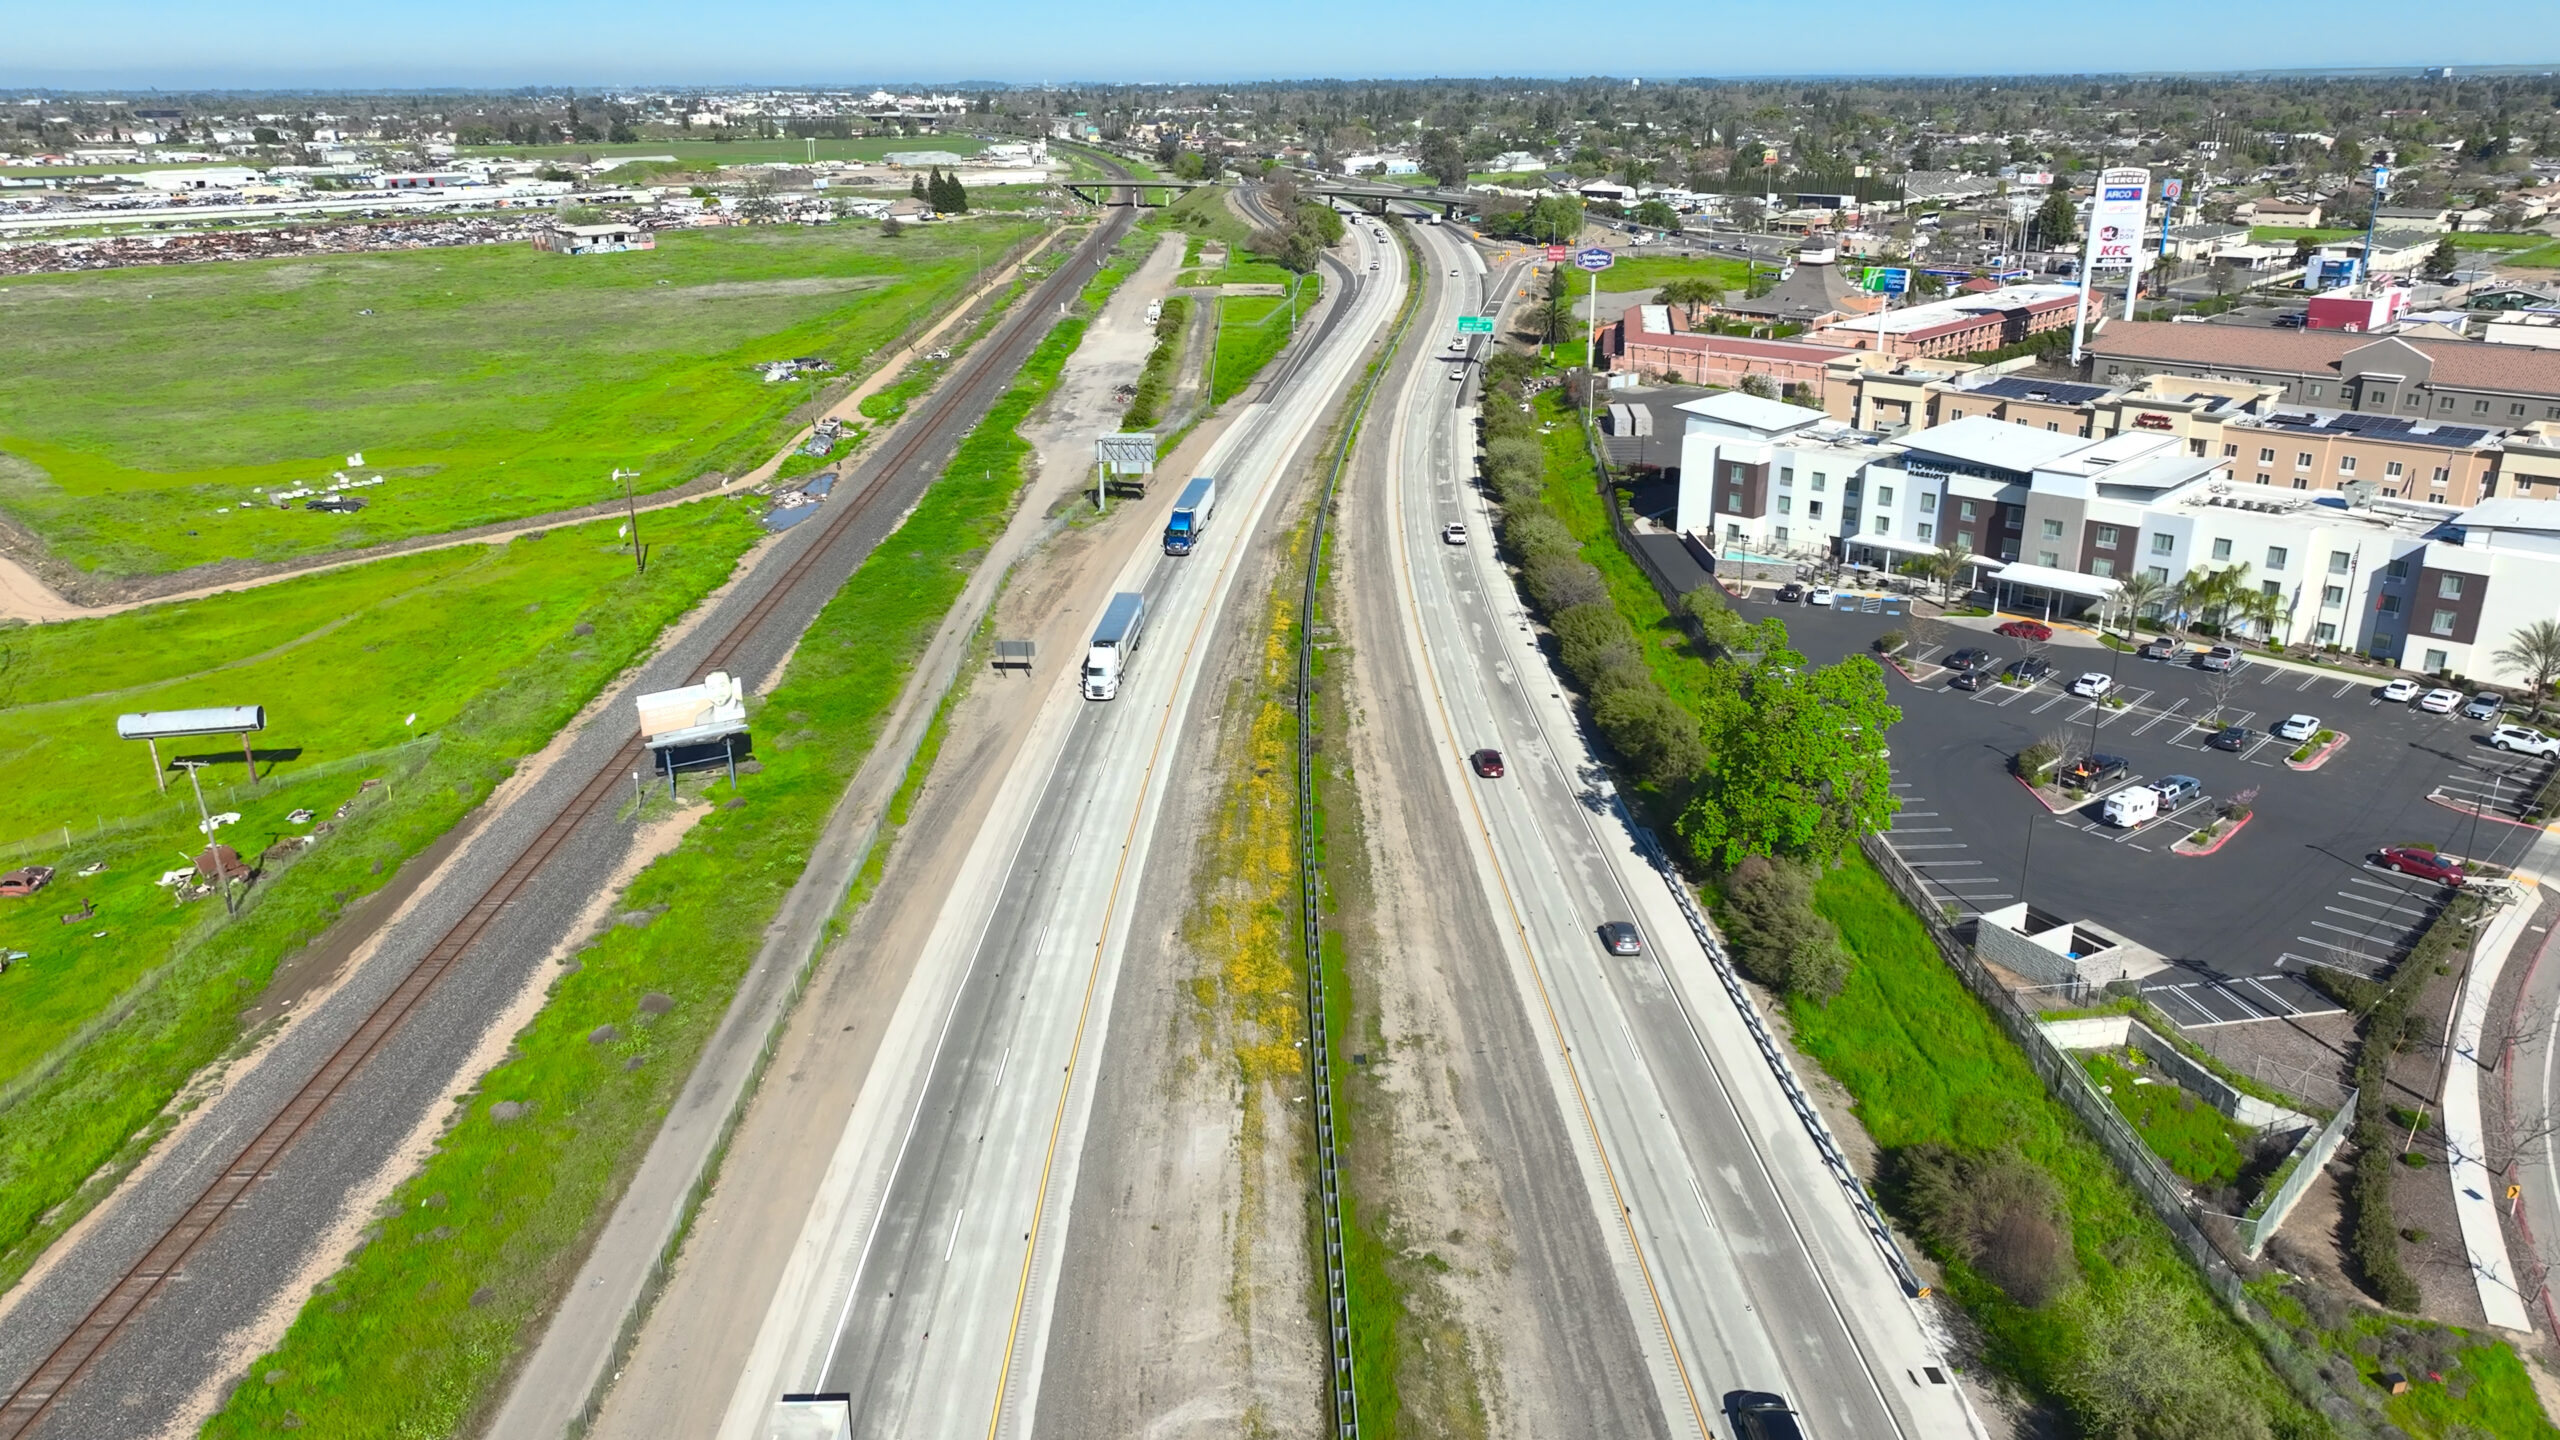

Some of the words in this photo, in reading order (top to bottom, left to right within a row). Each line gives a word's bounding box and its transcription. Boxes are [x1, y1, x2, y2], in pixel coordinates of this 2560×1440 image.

[2106, 190, 2131, 198] ARCO
[2166, 181, 2179, 197] 6
[2100, 246, 2131, 255] KFC
[1910, 460, 1987, 478] TOWNEPLACE
[1908, 470, 1949, 481] MARRIOTT
